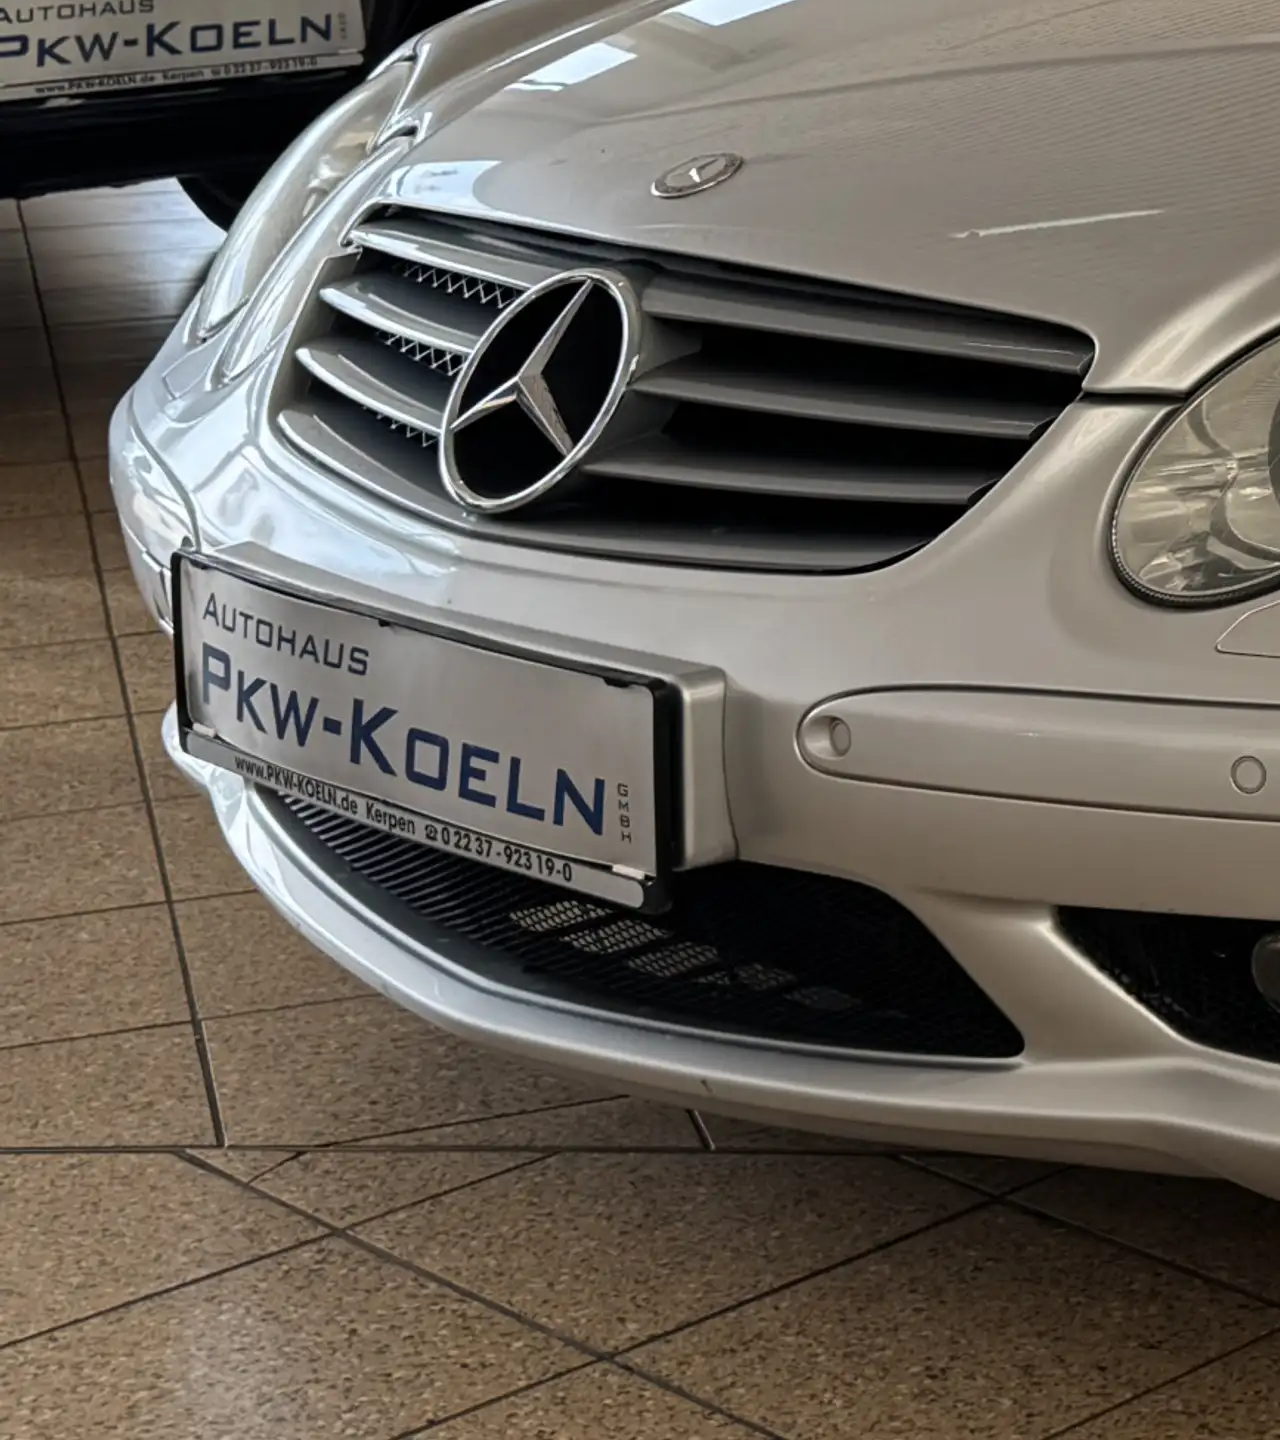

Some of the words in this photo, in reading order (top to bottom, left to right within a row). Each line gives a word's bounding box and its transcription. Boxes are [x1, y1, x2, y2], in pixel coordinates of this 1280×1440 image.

[202, 592, 369, 676] AUTOHAUS
[202, 642, 605, 836] PKW-KOELN
[234, 755, 358, 816] www.PKW-KOELN.de
[366, 798, 416, 836] Kerpen
